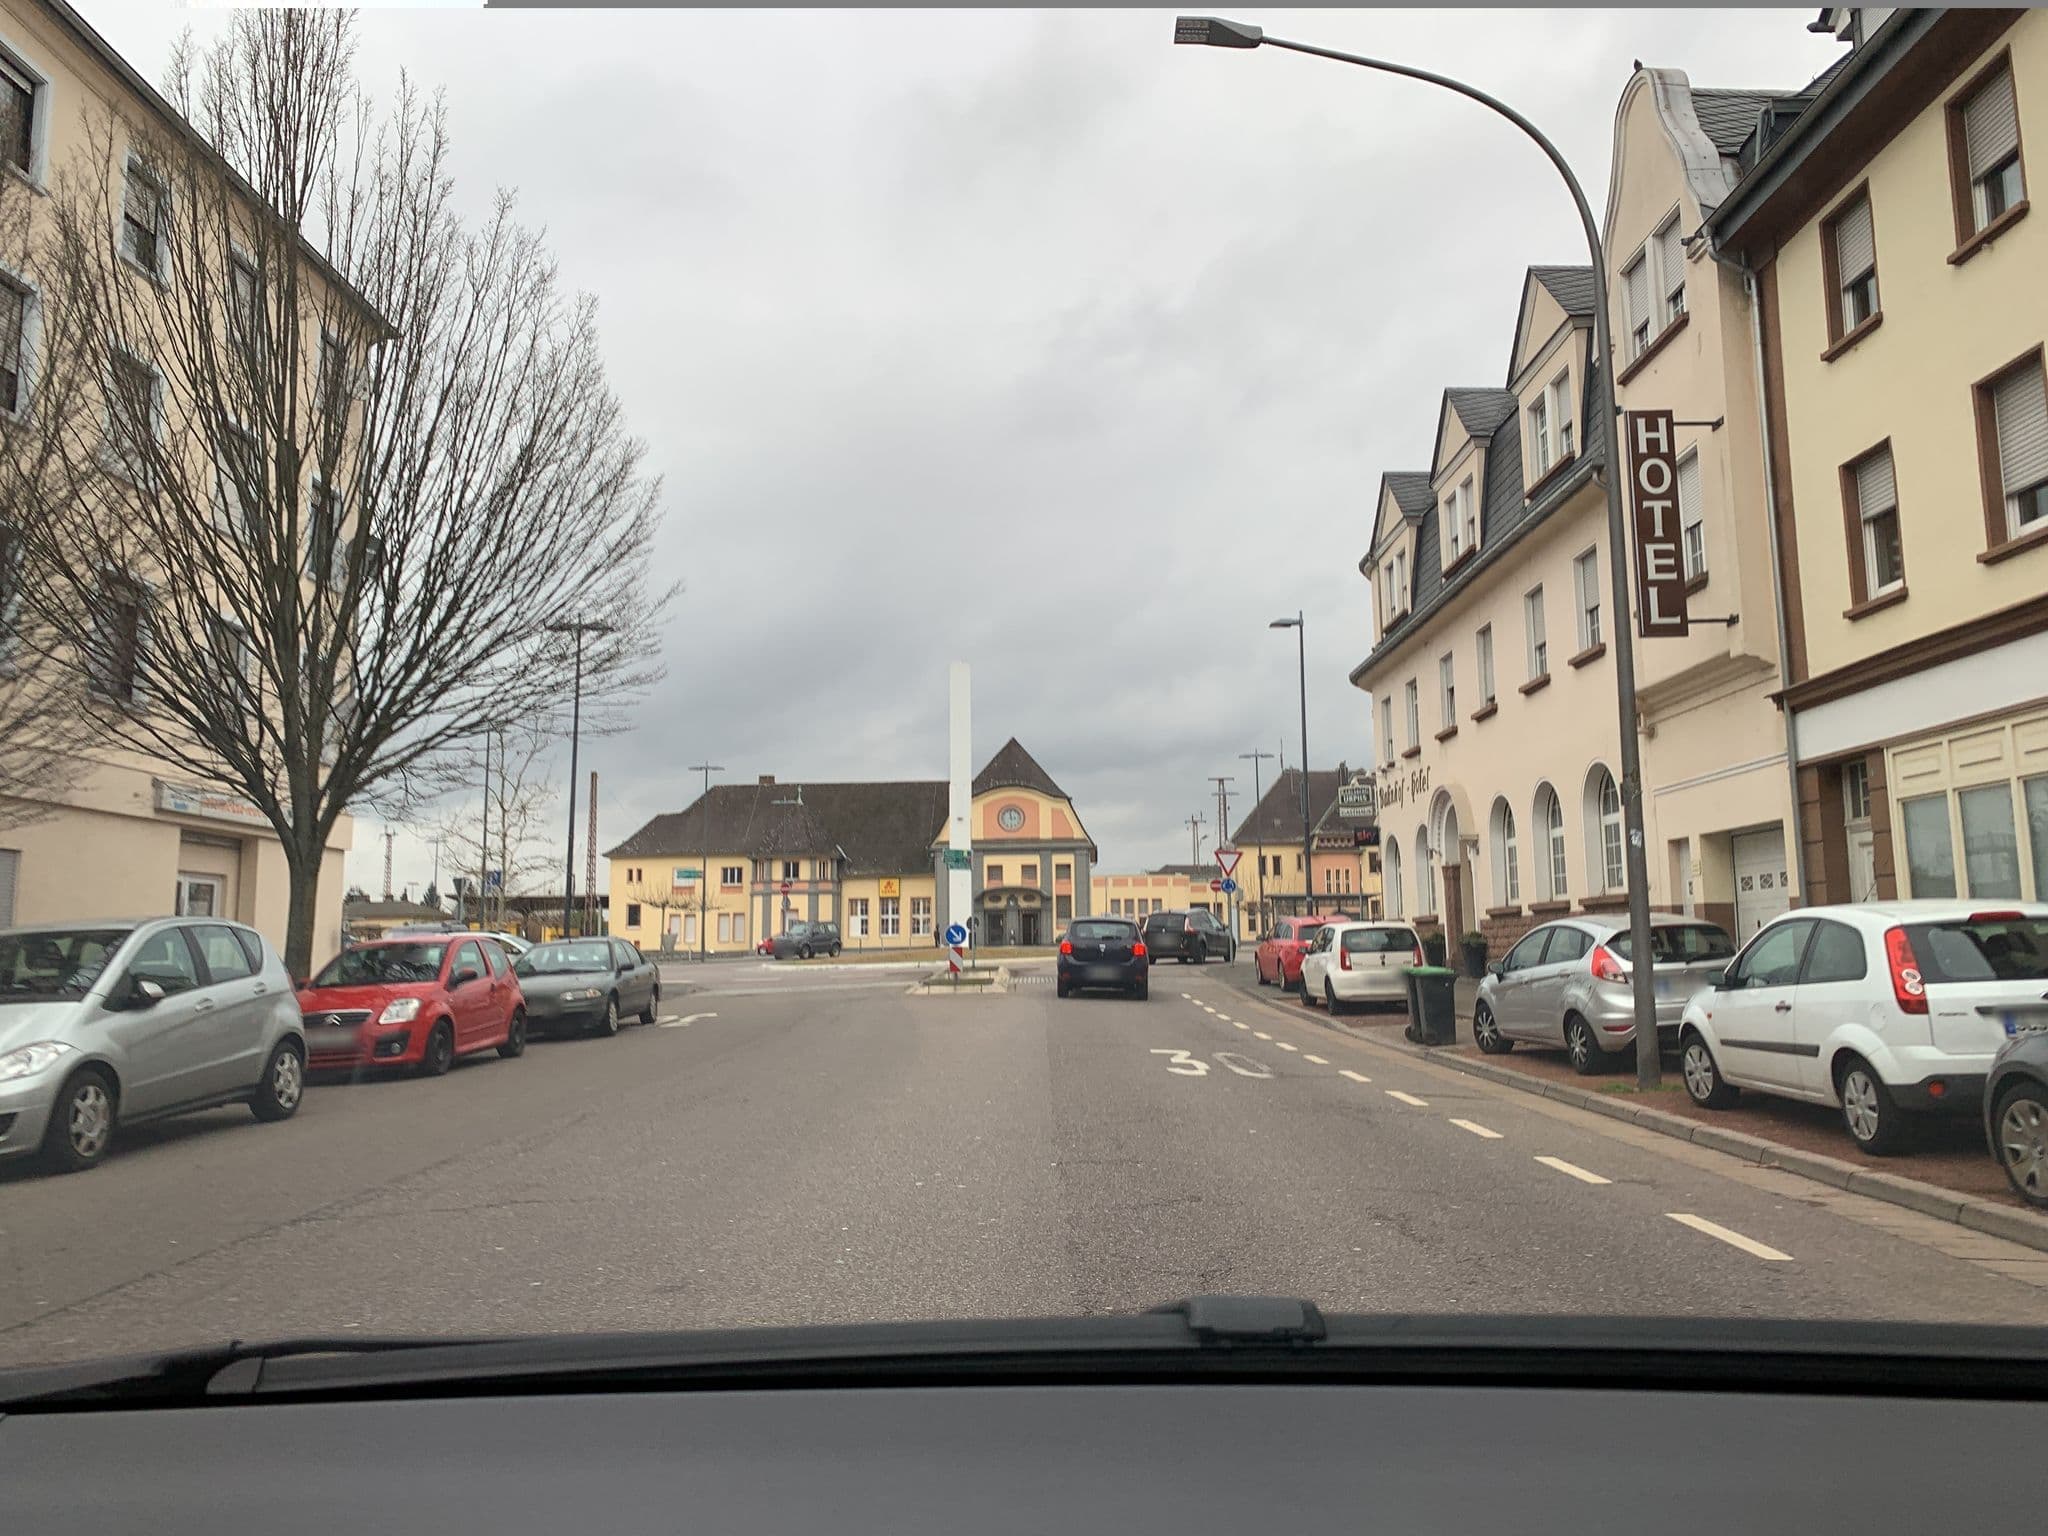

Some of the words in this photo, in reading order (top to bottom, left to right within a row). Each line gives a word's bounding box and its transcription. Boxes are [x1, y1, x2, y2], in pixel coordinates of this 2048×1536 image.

[1636, 417, 1681, 625] HOTEL
[1411, 765, 1431, 803] Hotel
[1150, 1049, 1275, 1079] 30
